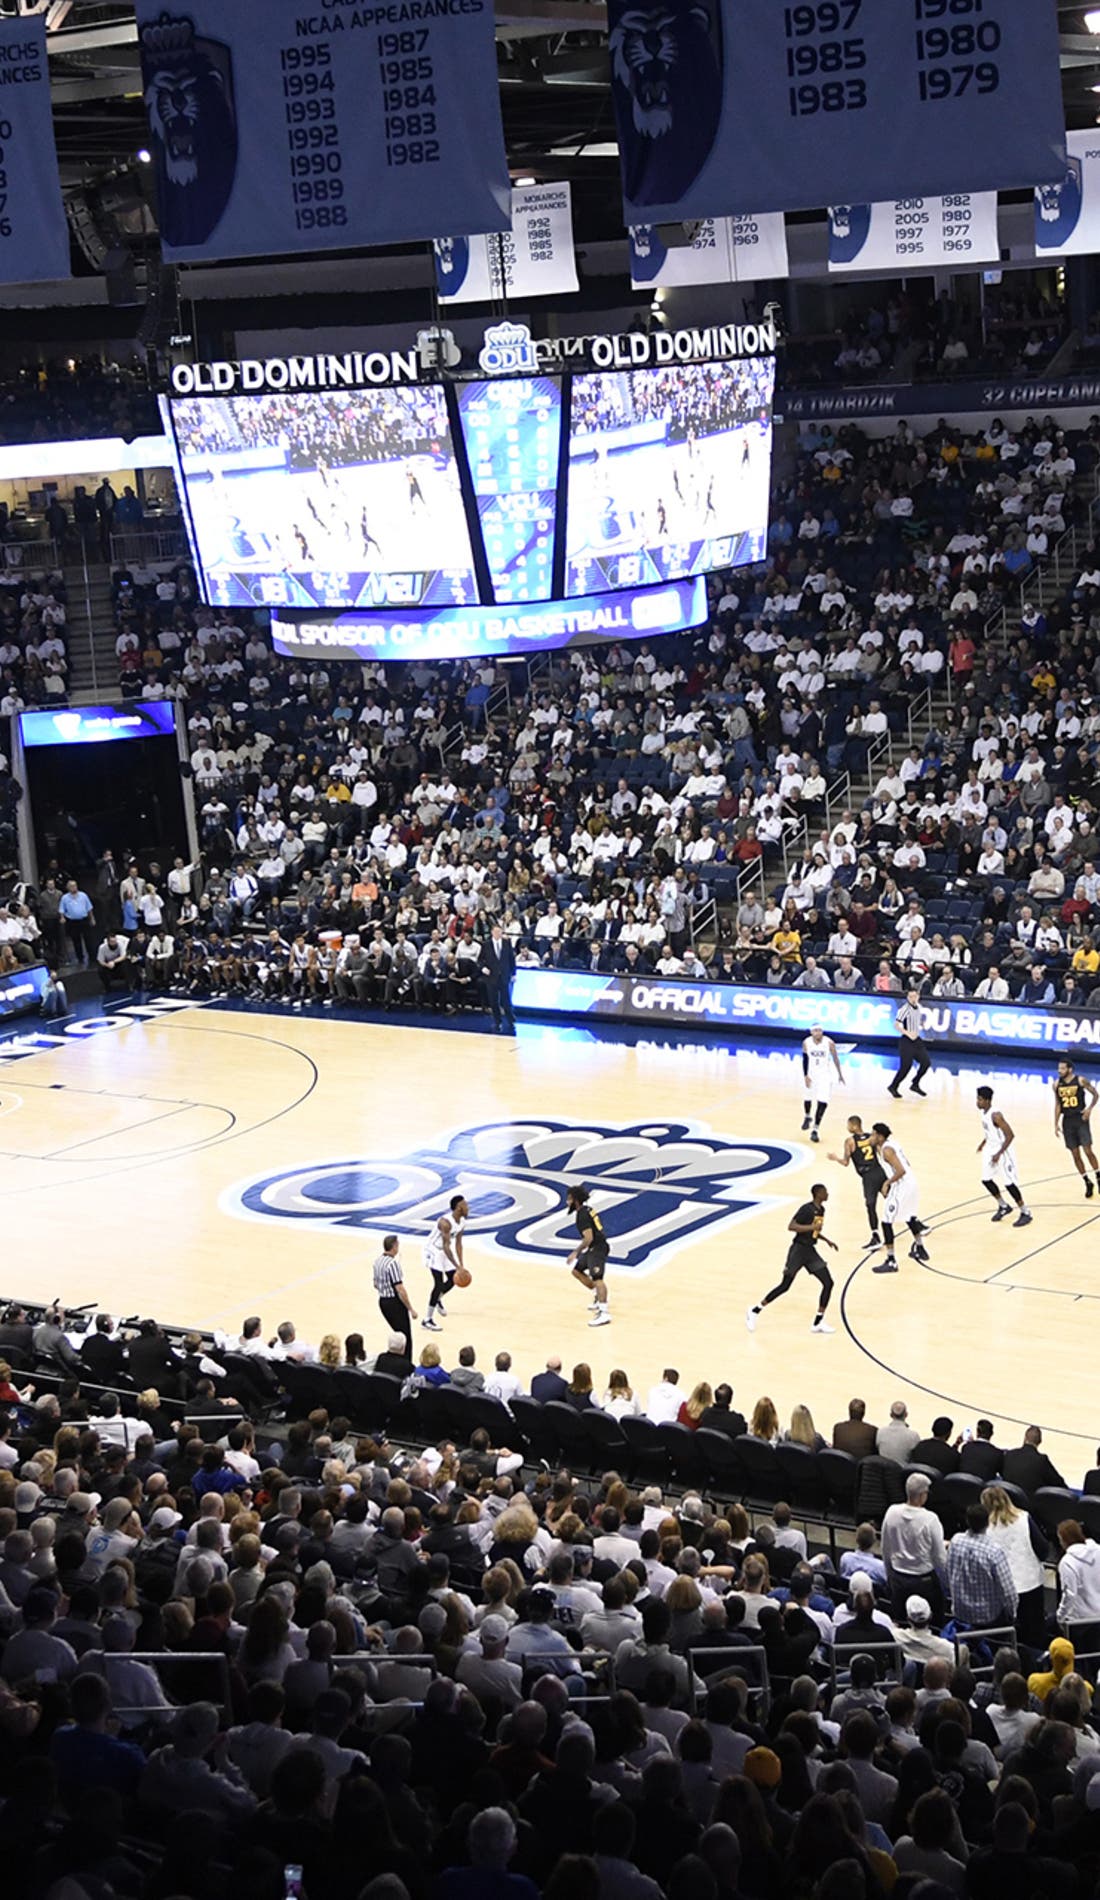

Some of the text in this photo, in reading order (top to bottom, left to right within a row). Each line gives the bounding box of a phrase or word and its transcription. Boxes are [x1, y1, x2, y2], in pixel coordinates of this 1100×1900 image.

[296, 0, 484, 37] NCAA APPEARANCES
[784, 0, 863, 38] 1997
[378, 29, 430, 58] 1987
[916, 20, 1001, 61] 1980
[281, 43, 332, 70] 1995
[786, 38, 867, 77] 1985
[283, 71, 335, 97] 1994
[379, 57, 433, 85] 1985
[918, 62, 999, 101] 1979
[286, 98, 336, 124] 1993
[383, 85, 437, 112] 1984
[789, 79, 868, 117] 1983
[288, 124, 339, 150] 1992
[384, 112, 437, 139] 1983
[290, 151, 342, 177] 1990
[386, 140, 441, 166] 1982
[292, 178, 344, 204] 1989
[942, 195, 970, 207] 1982
[295, 205, 348, 230] 1988
[515, 201, 567, 214] APPEARANCES
[895, 198, 924, 211] 2010
[942, 209, 972, 222] 1980
[527, 217, 551, 229] 1992
[895, 212, 930, 225] 2005
[943, 225, 970, 237] 1977
[528, 228, 552, 240] 1986
[529, 240, 553, 251] 1985
[896, 227, 923, 240] 1997
[943, 239, 972, 251] 1969
[530, 250, 553, 262] 1982
[896, 241, 924, 254] 1995
[483, 344, 535, 372] ODU
[592, 333, 650, 367] OLD
[655, 324, 776, 362] DOMINION
[172, 351, 418, 393] OLD DOMINION
[300, 624, 385, 646] SPONSOR
[391, 623, 423, 643] OF
[484, 606, 628, 640] BASKETBALL
[631, 985, 727, 1015] OFFICIAL
[733, 993, 851, 1024] SPONSOR
[856, 1001, 892, 1024] OF
[1062, 1096, 1079, 1108] 20
[241, 1160, 760, 1268] ODU
